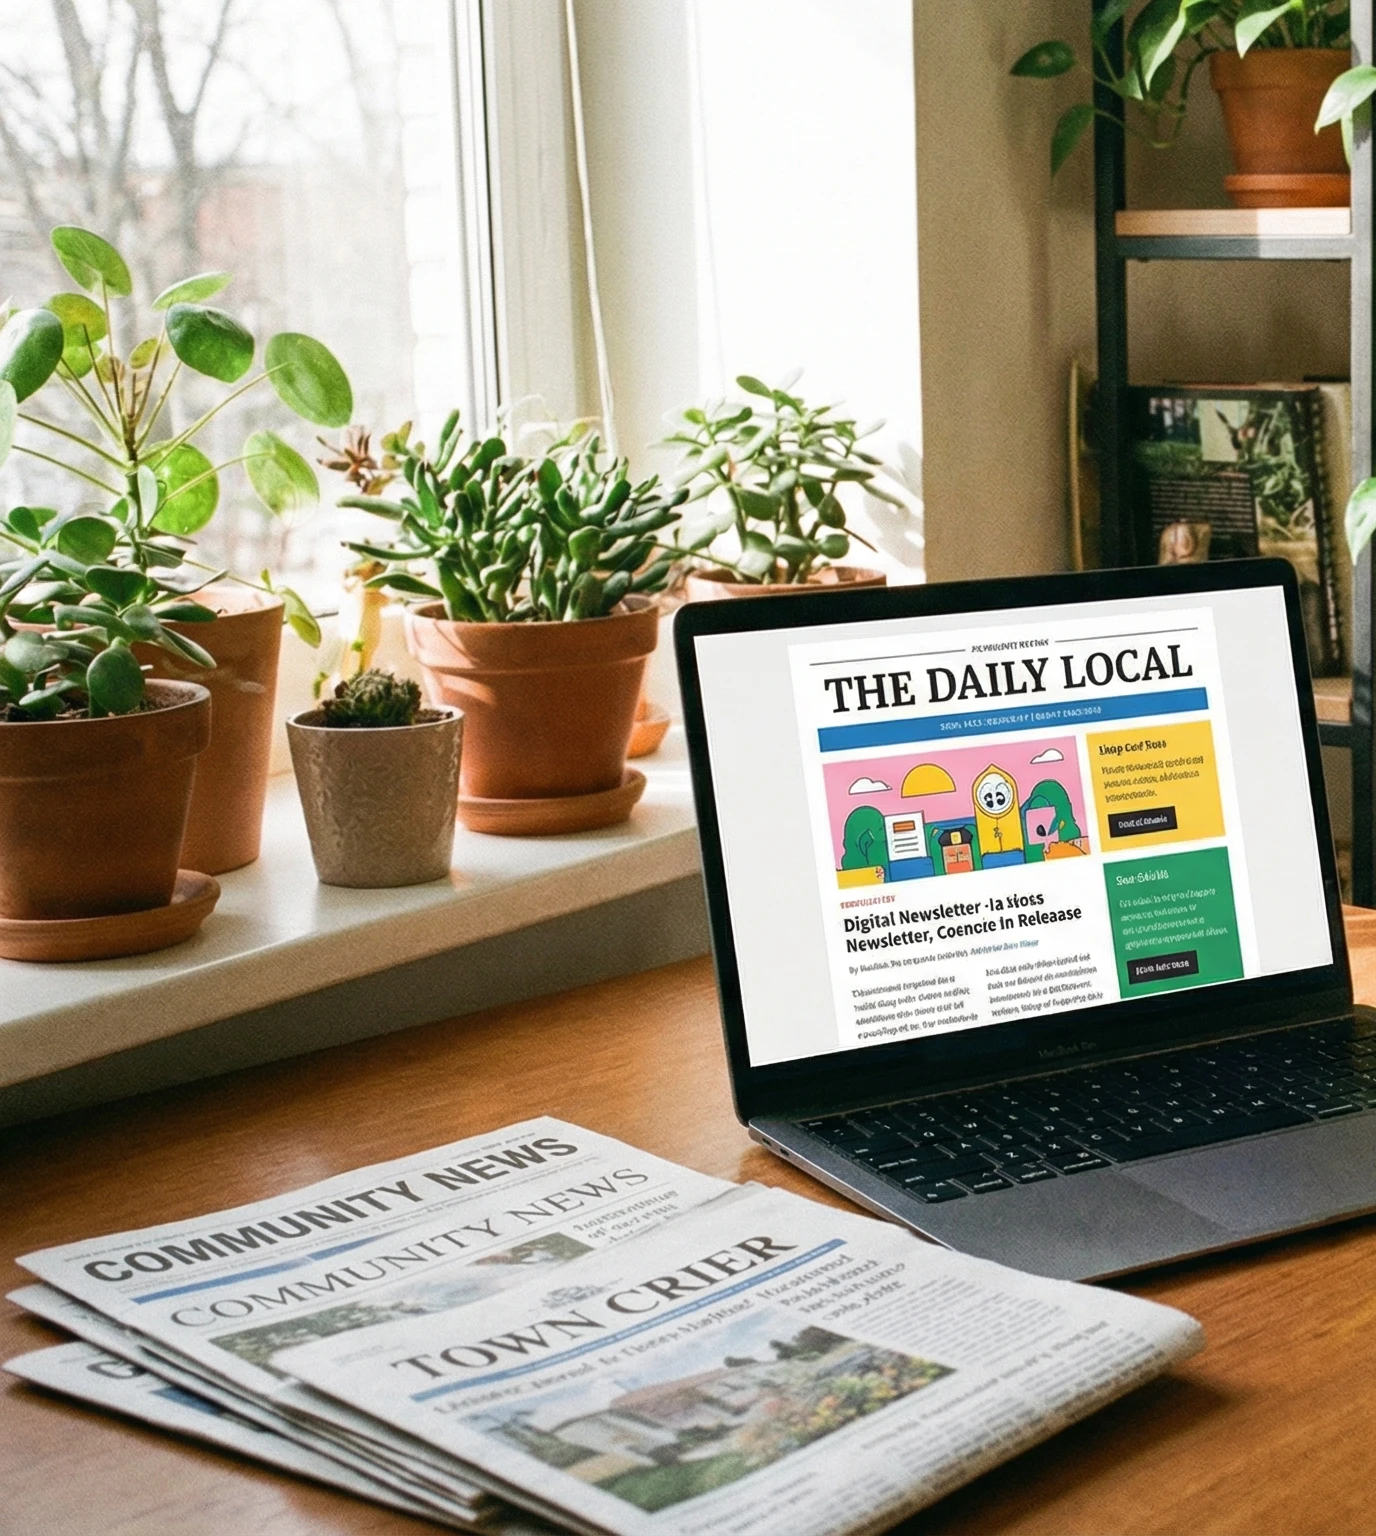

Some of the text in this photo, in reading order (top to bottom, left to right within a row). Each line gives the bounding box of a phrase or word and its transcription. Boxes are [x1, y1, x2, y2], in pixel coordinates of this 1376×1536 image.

[824, 644, 1193, 713] THE DAILY LOCAL
[844, 910, 896, 934] Digital
[898, 902, 981, 925] Newsletter
[846, 931, 934, 953] Newsletter,
[1018, 907, 1082, 928] Releaase
[84, 1138, 578, 1283] COMMUNITY NEWS
[171, 1218, 503, 1328] COMMUNITY
[504, 1168, 649, 1226] NEWS
[390, 1309, 607, 1381] TOWN
[606, 1236, 799, 1314] CRIER
